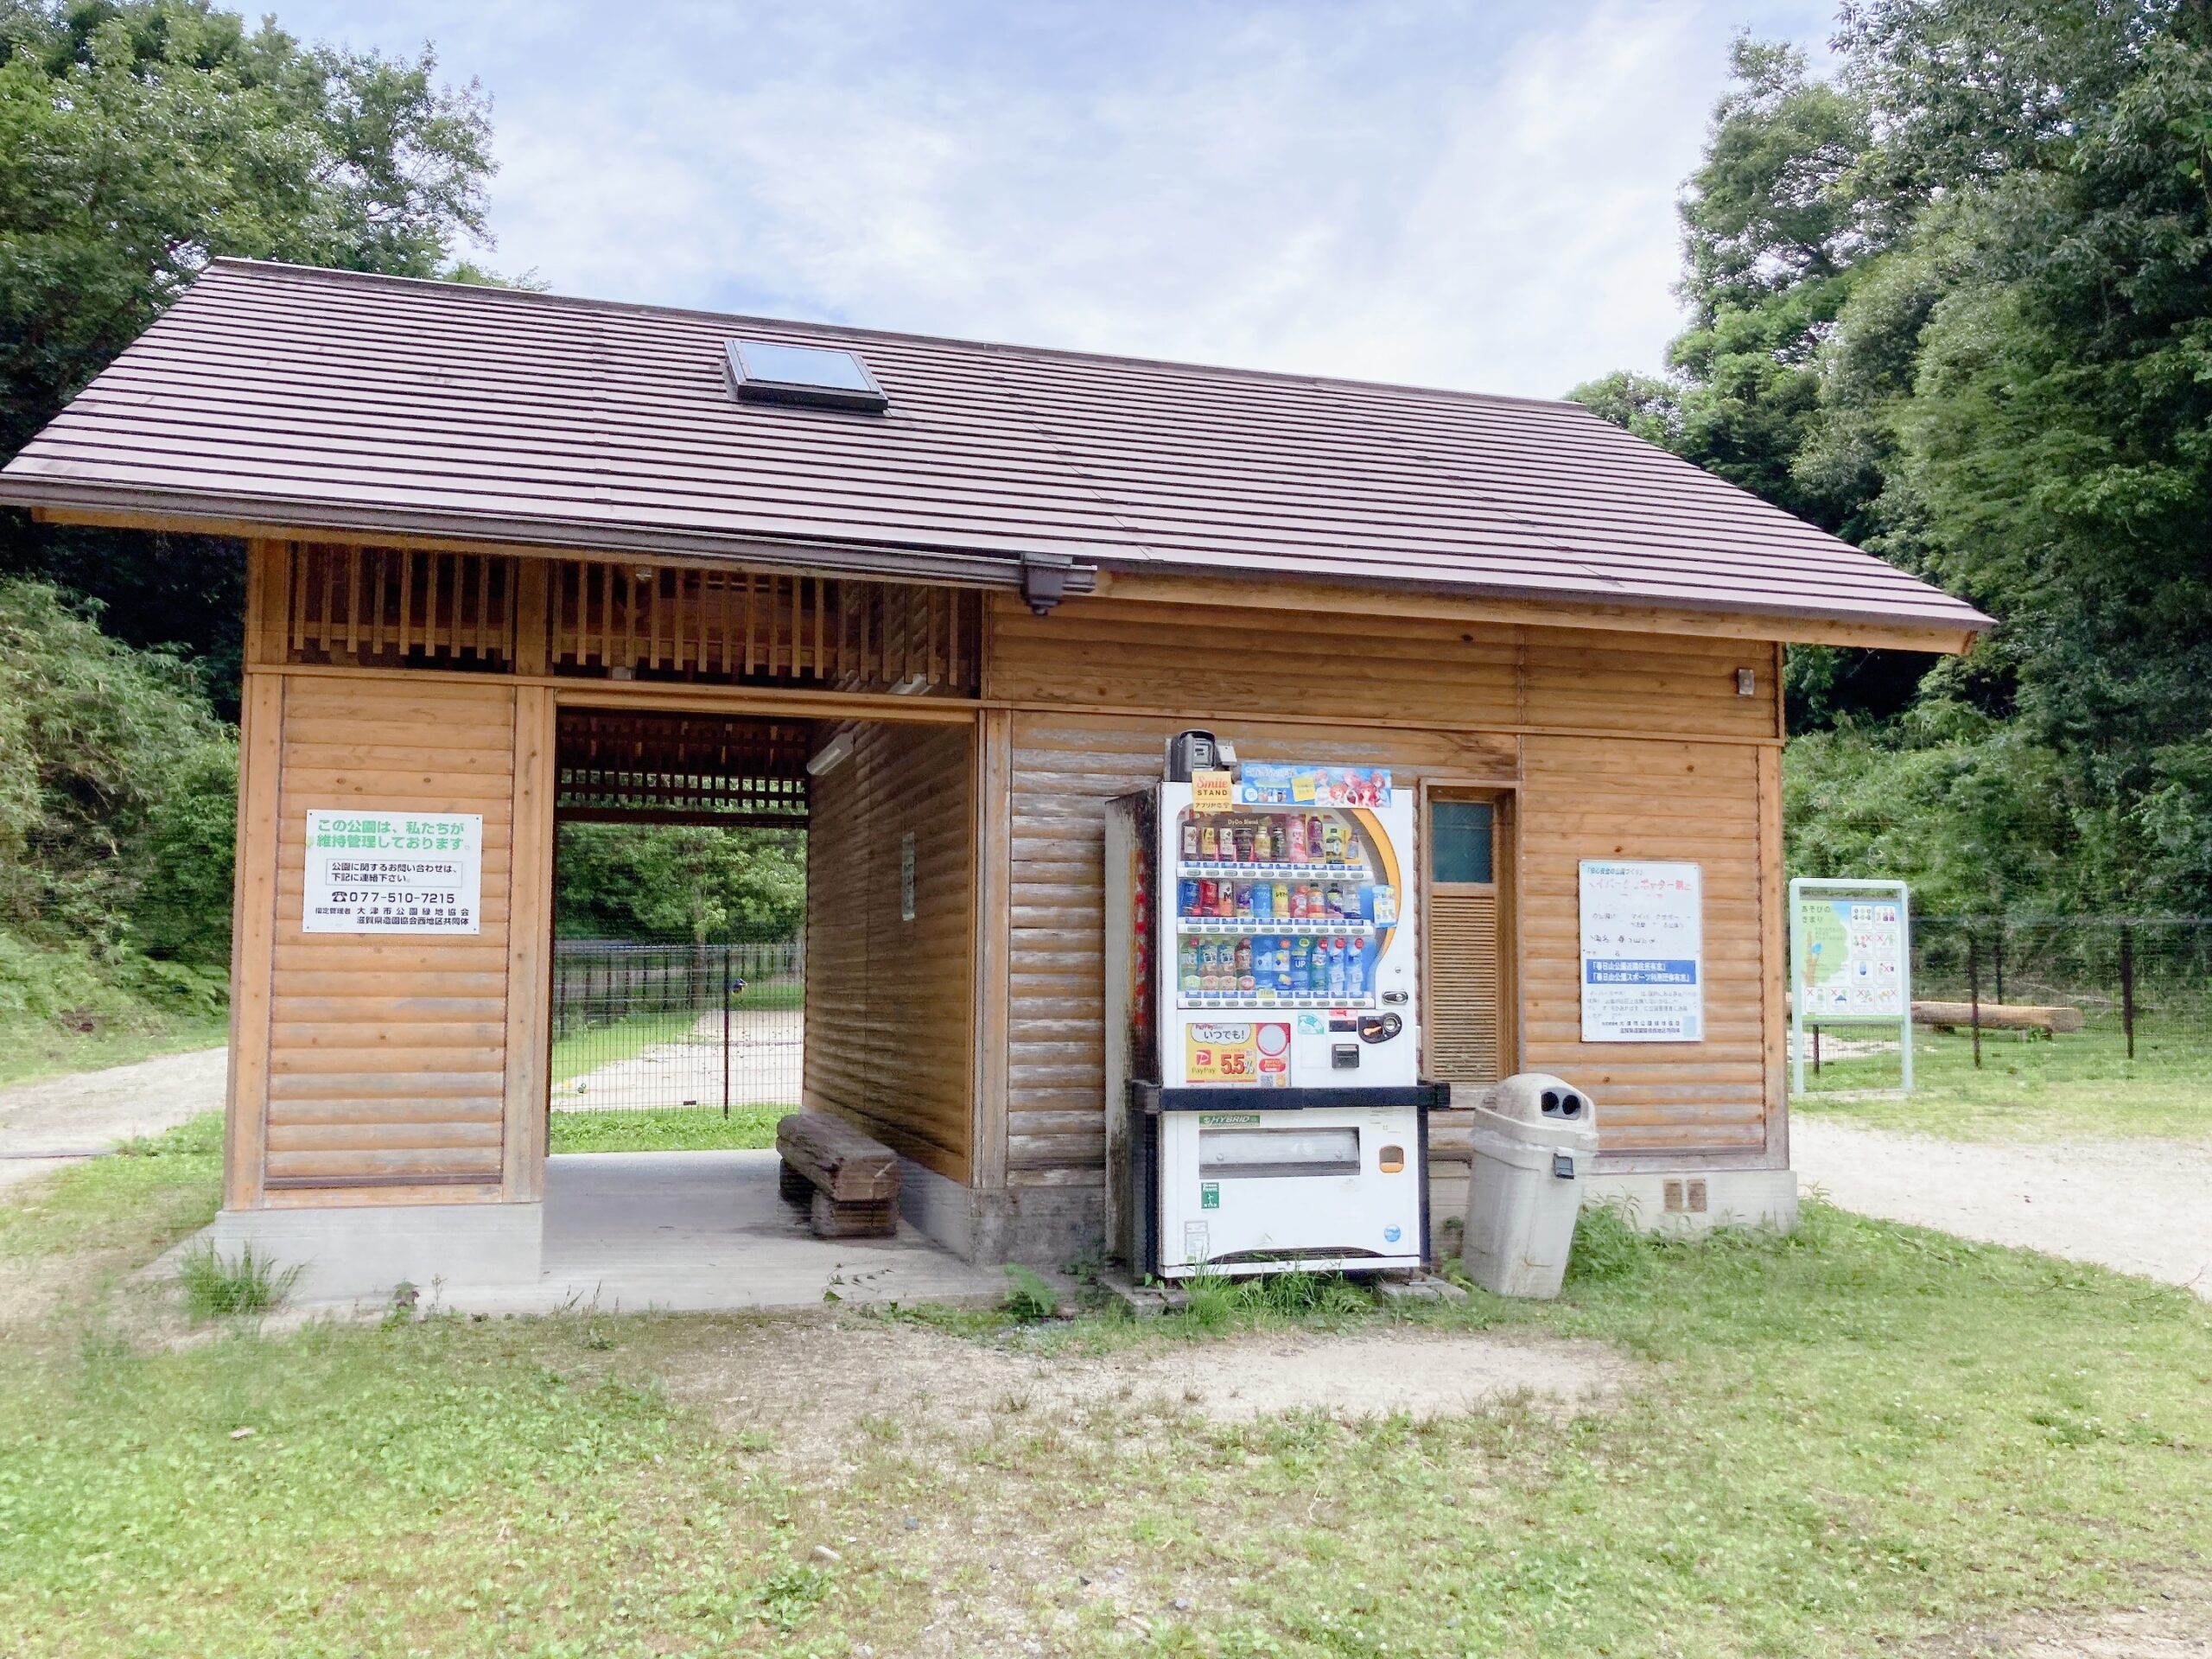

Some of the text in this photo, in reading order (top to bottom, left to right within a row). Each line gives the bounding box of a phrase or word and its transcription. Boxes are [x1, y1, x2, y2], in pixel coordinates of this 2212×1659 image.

[1197, 776, 1228, 788] Smile
[318, 819, 464, 835] この公園は、私たちが
[316, 835, 470, 850] 維持管理しております。
[332, 862, 457, 873] 公園に関するお問い合わせは、
[349, 892, 454, 904] 077-510-7215
[1211, 1116, 1250, 1124] HYBRID
